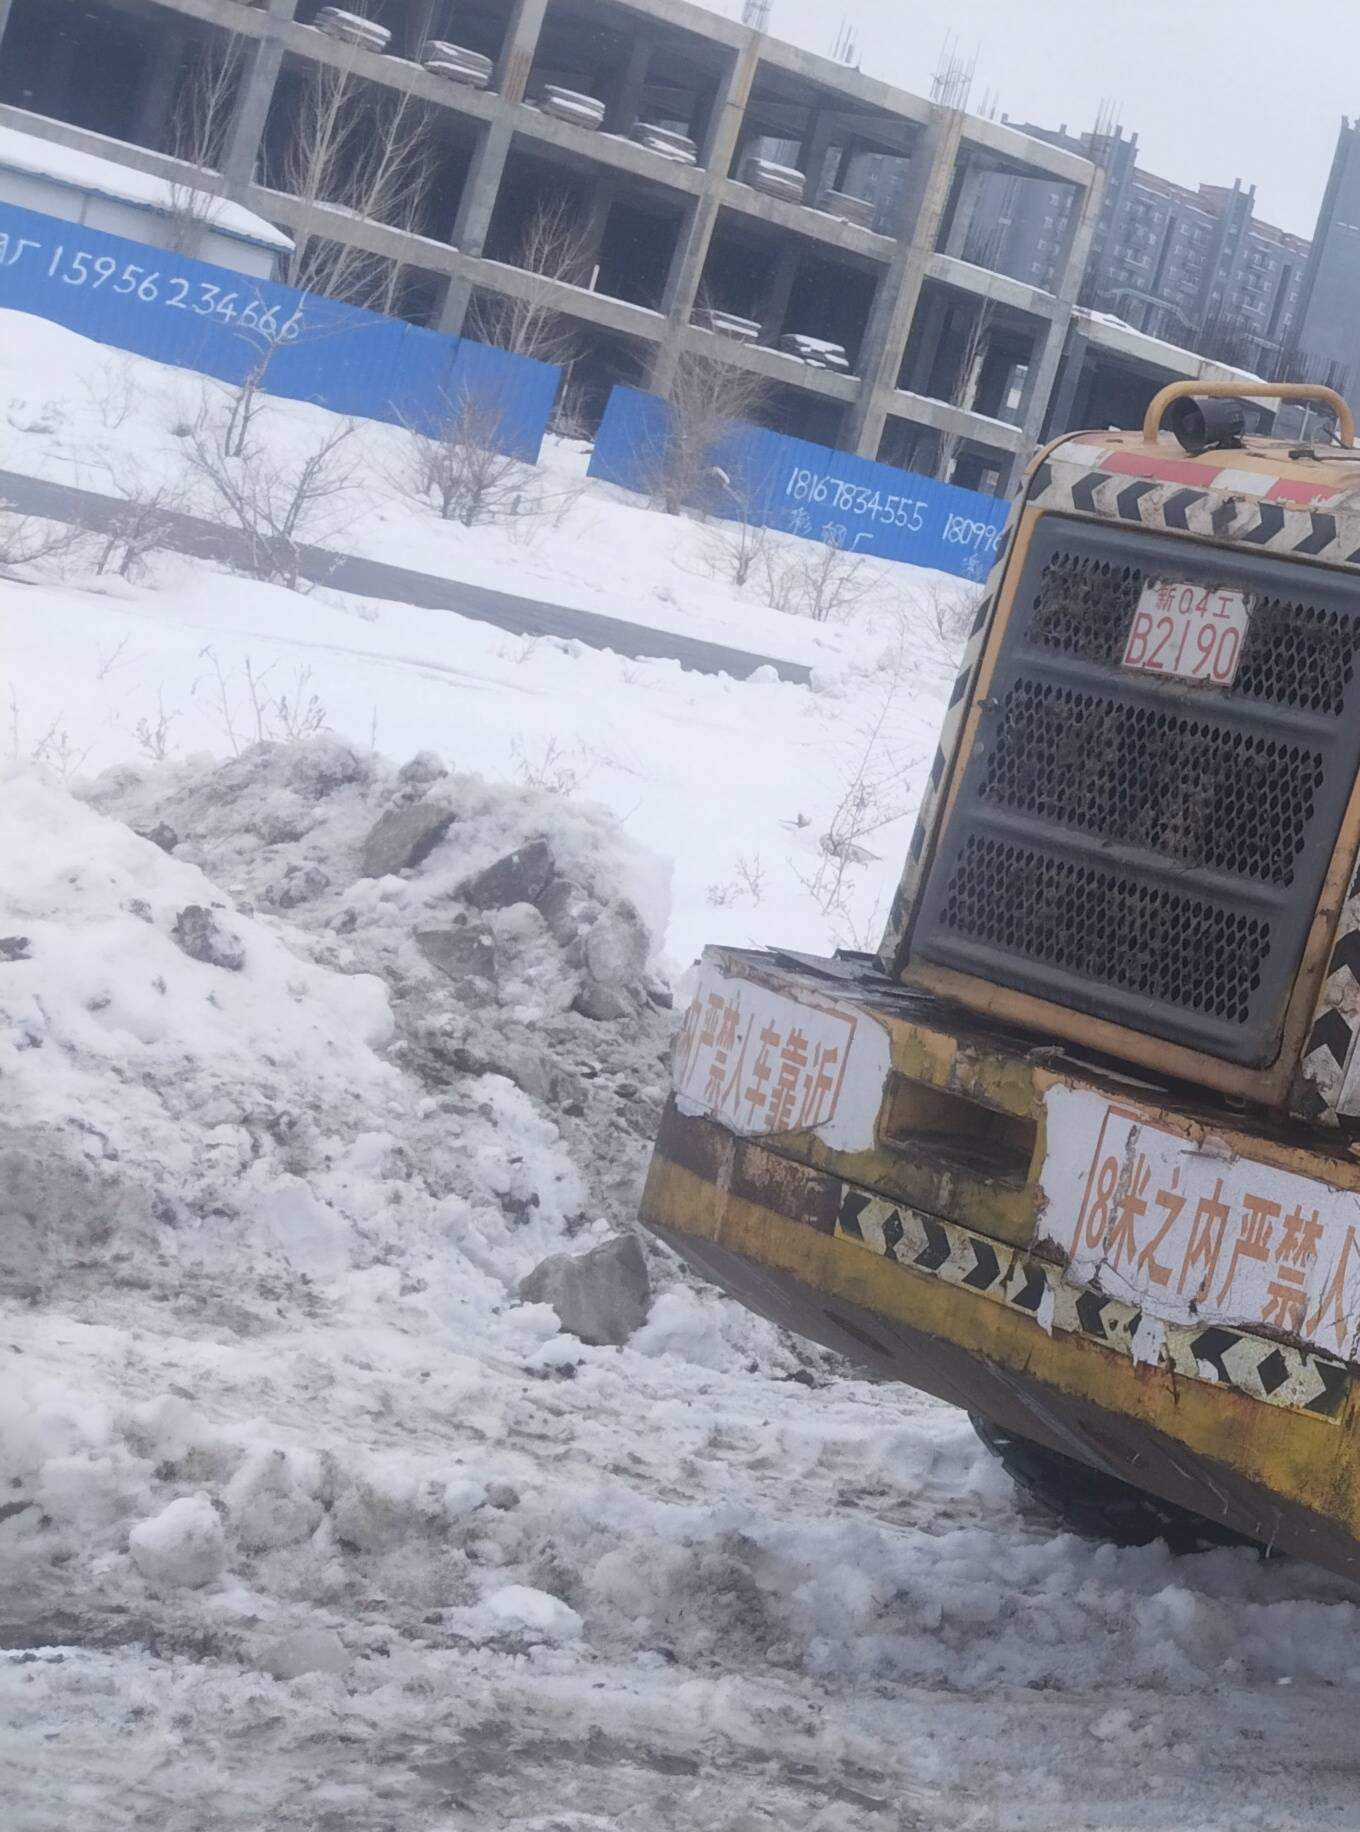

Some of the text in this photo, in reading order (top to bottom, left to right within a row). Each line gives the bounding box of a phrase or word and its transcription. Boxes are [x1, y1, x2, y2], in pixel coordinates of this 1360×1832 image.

[48, 245, 303, 339] 15956234666
[786, 467, 929, 532] 18167834555
[1125, 612, 1240, 679] B2190
